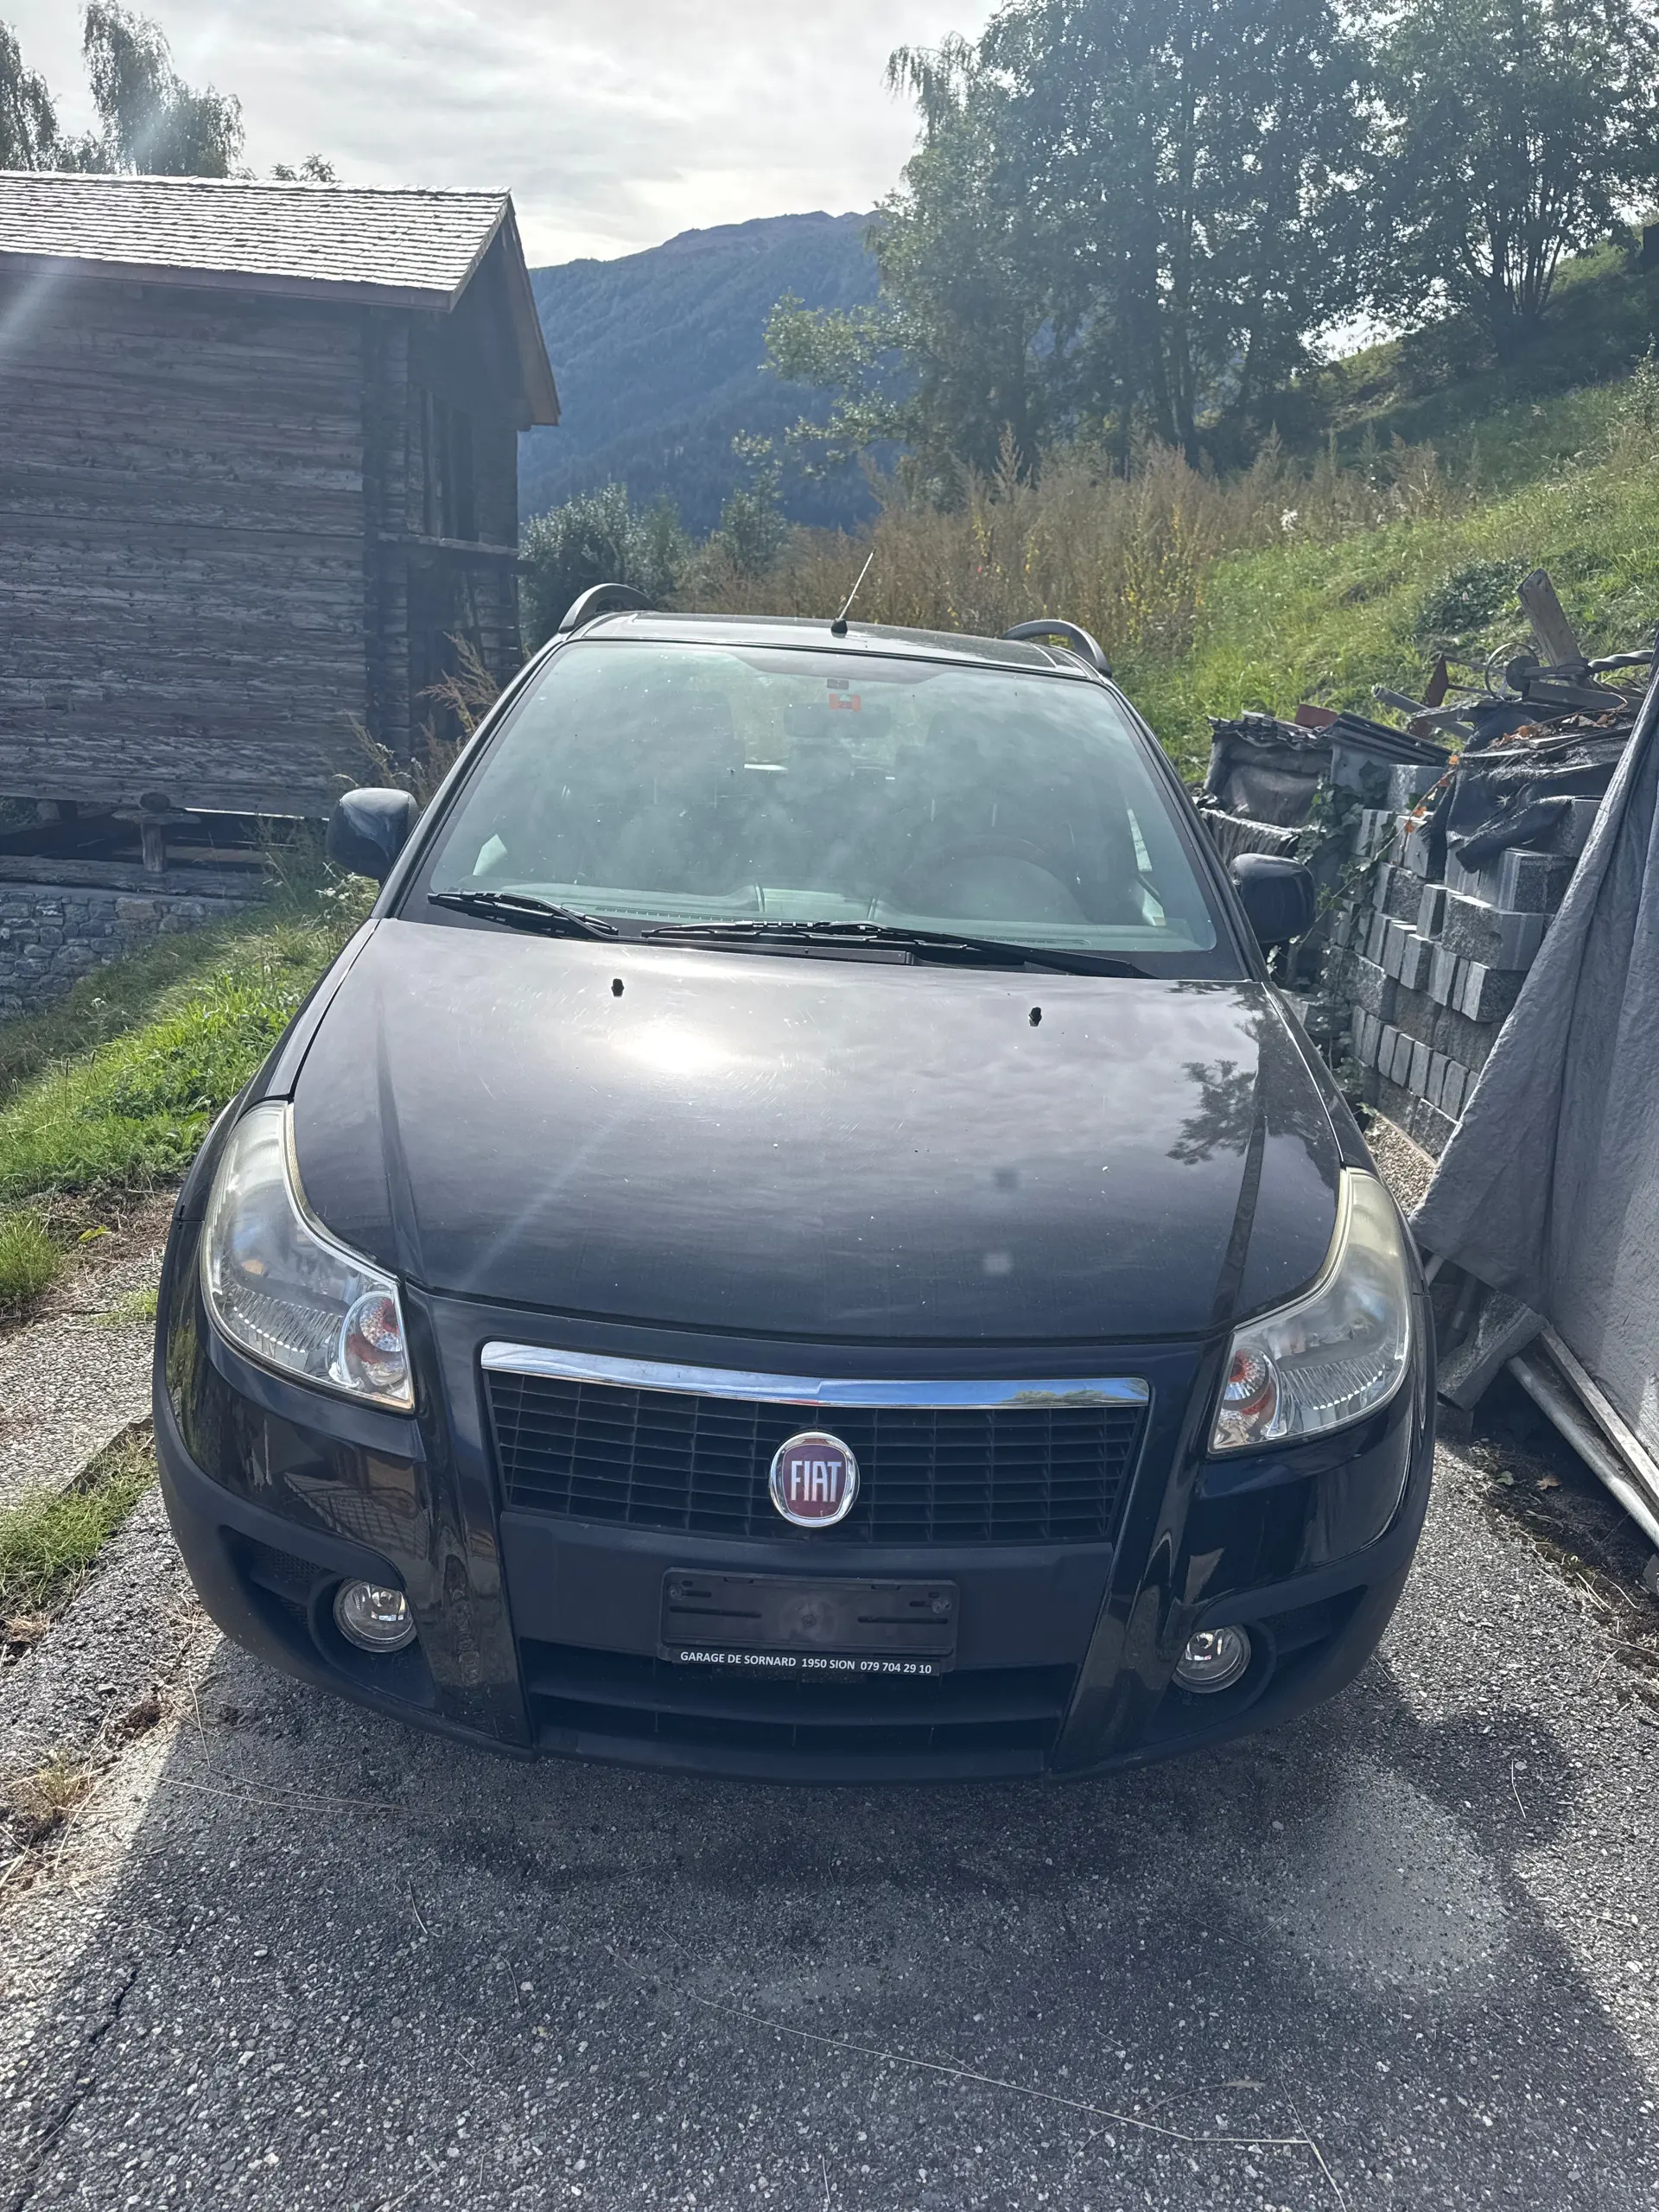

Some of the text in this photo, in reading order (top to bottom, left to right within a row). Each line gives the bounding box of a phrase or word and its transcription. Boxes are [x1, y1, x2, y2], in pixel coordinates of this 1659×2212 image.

[791, 1460, 842, 1502] FIAT
[680, 1651, 932, 1675] GARAGE DE SORNARD 1950 SION 079 704 29 10
